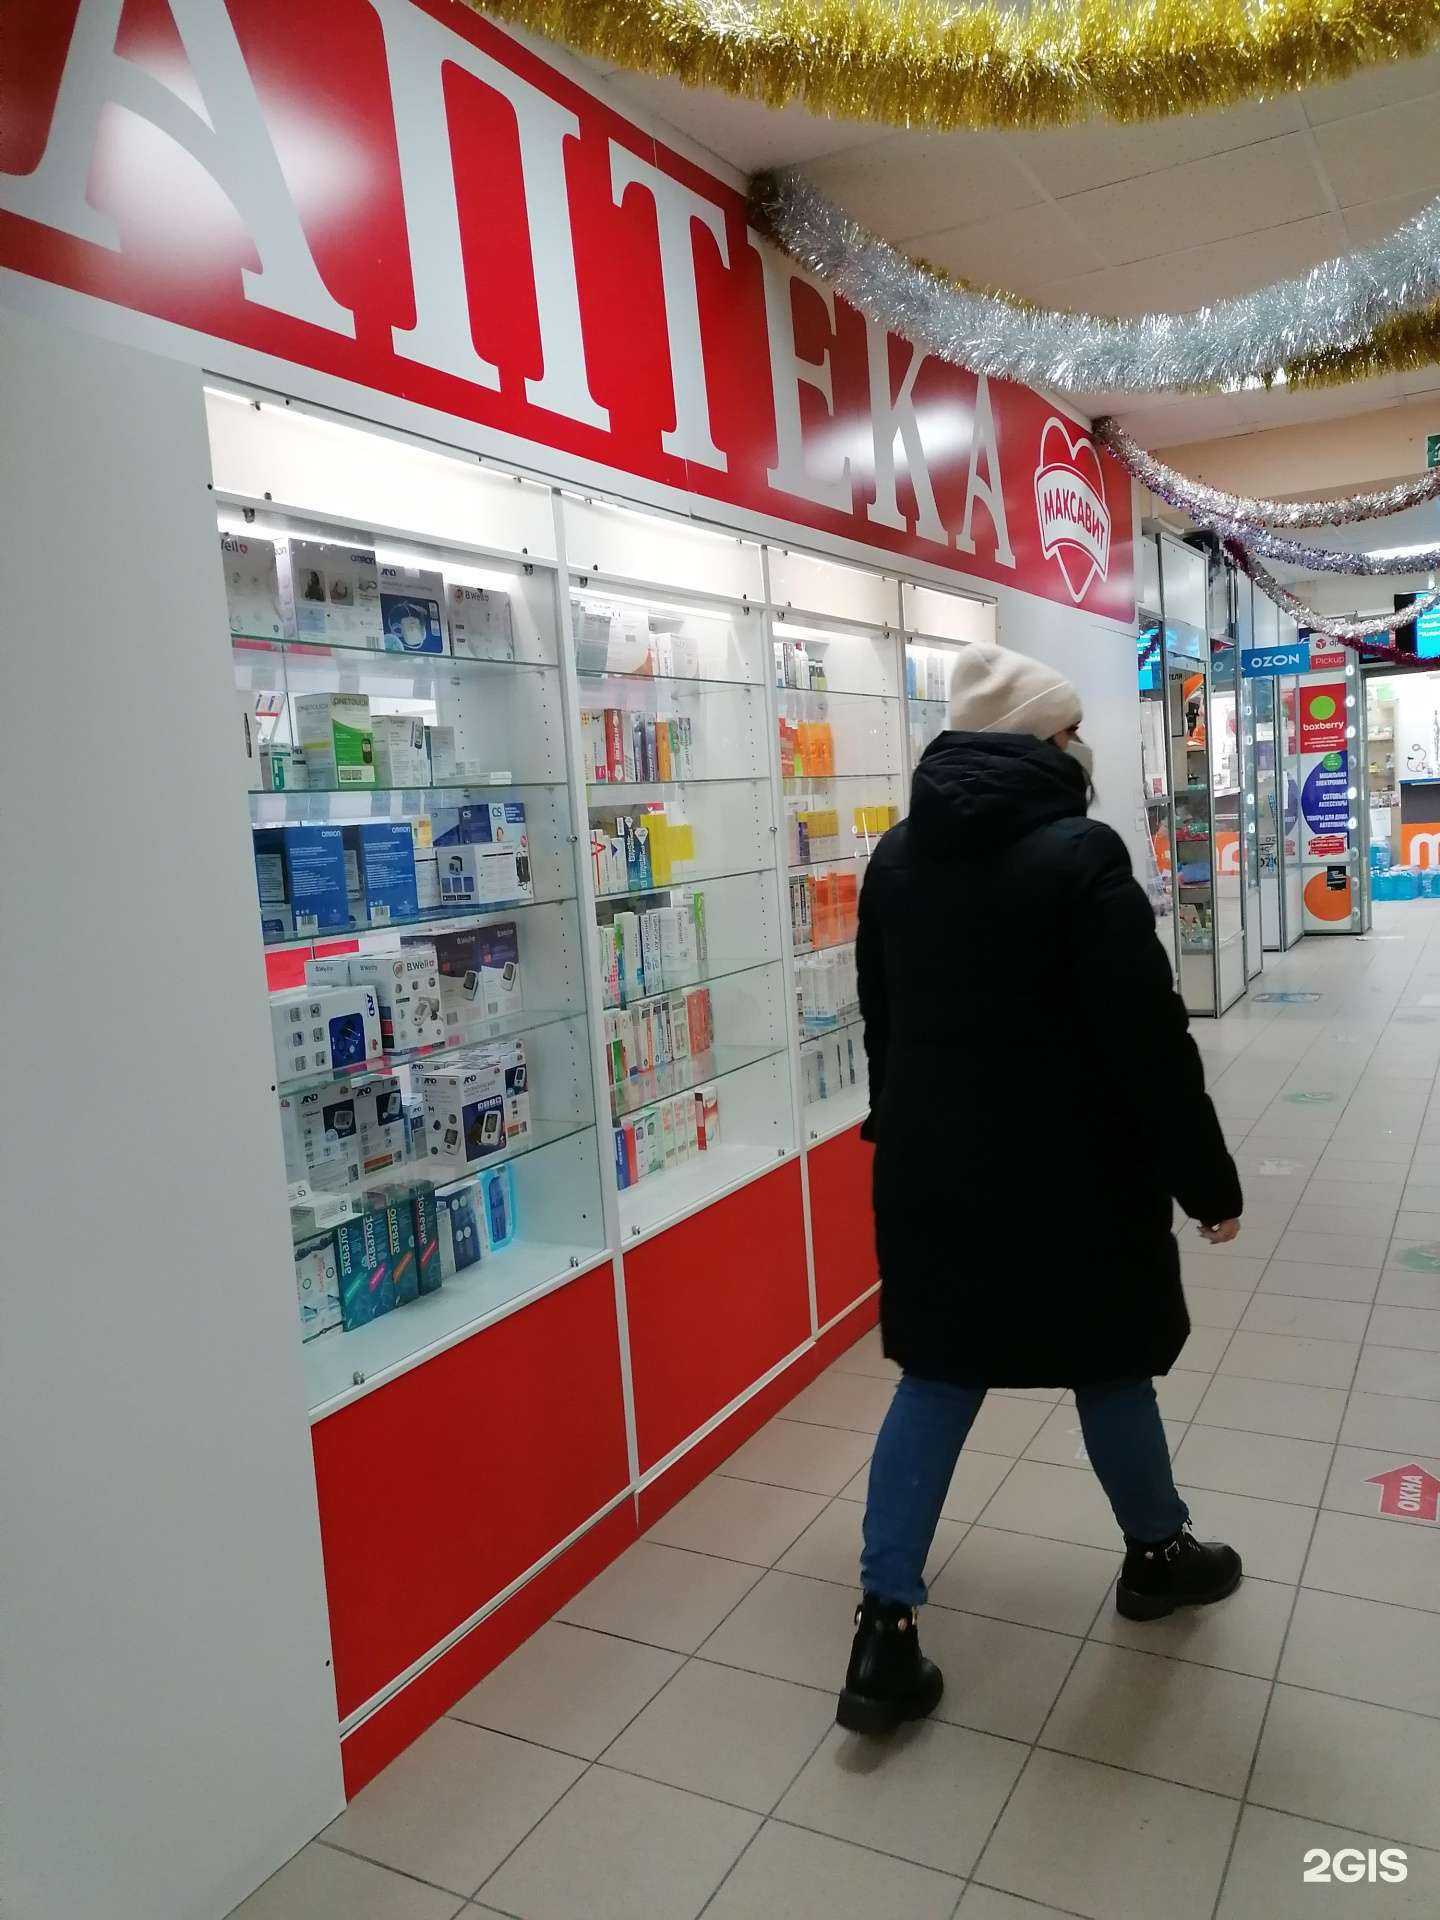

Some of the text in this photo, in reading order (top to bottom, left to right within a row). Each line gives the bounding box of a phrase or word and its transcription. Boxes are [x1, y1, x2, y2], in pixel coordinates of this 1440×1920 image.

[0, 0, 1016, 570] АПТЕКА
[1043, 487, 1106, 551] МАКСАВИТ
[1251, 653, 1300, 669] OZON
[1302, 721, 1345, 731] boxberry
[1397, 1475, 1424, 1512] ОКНА
